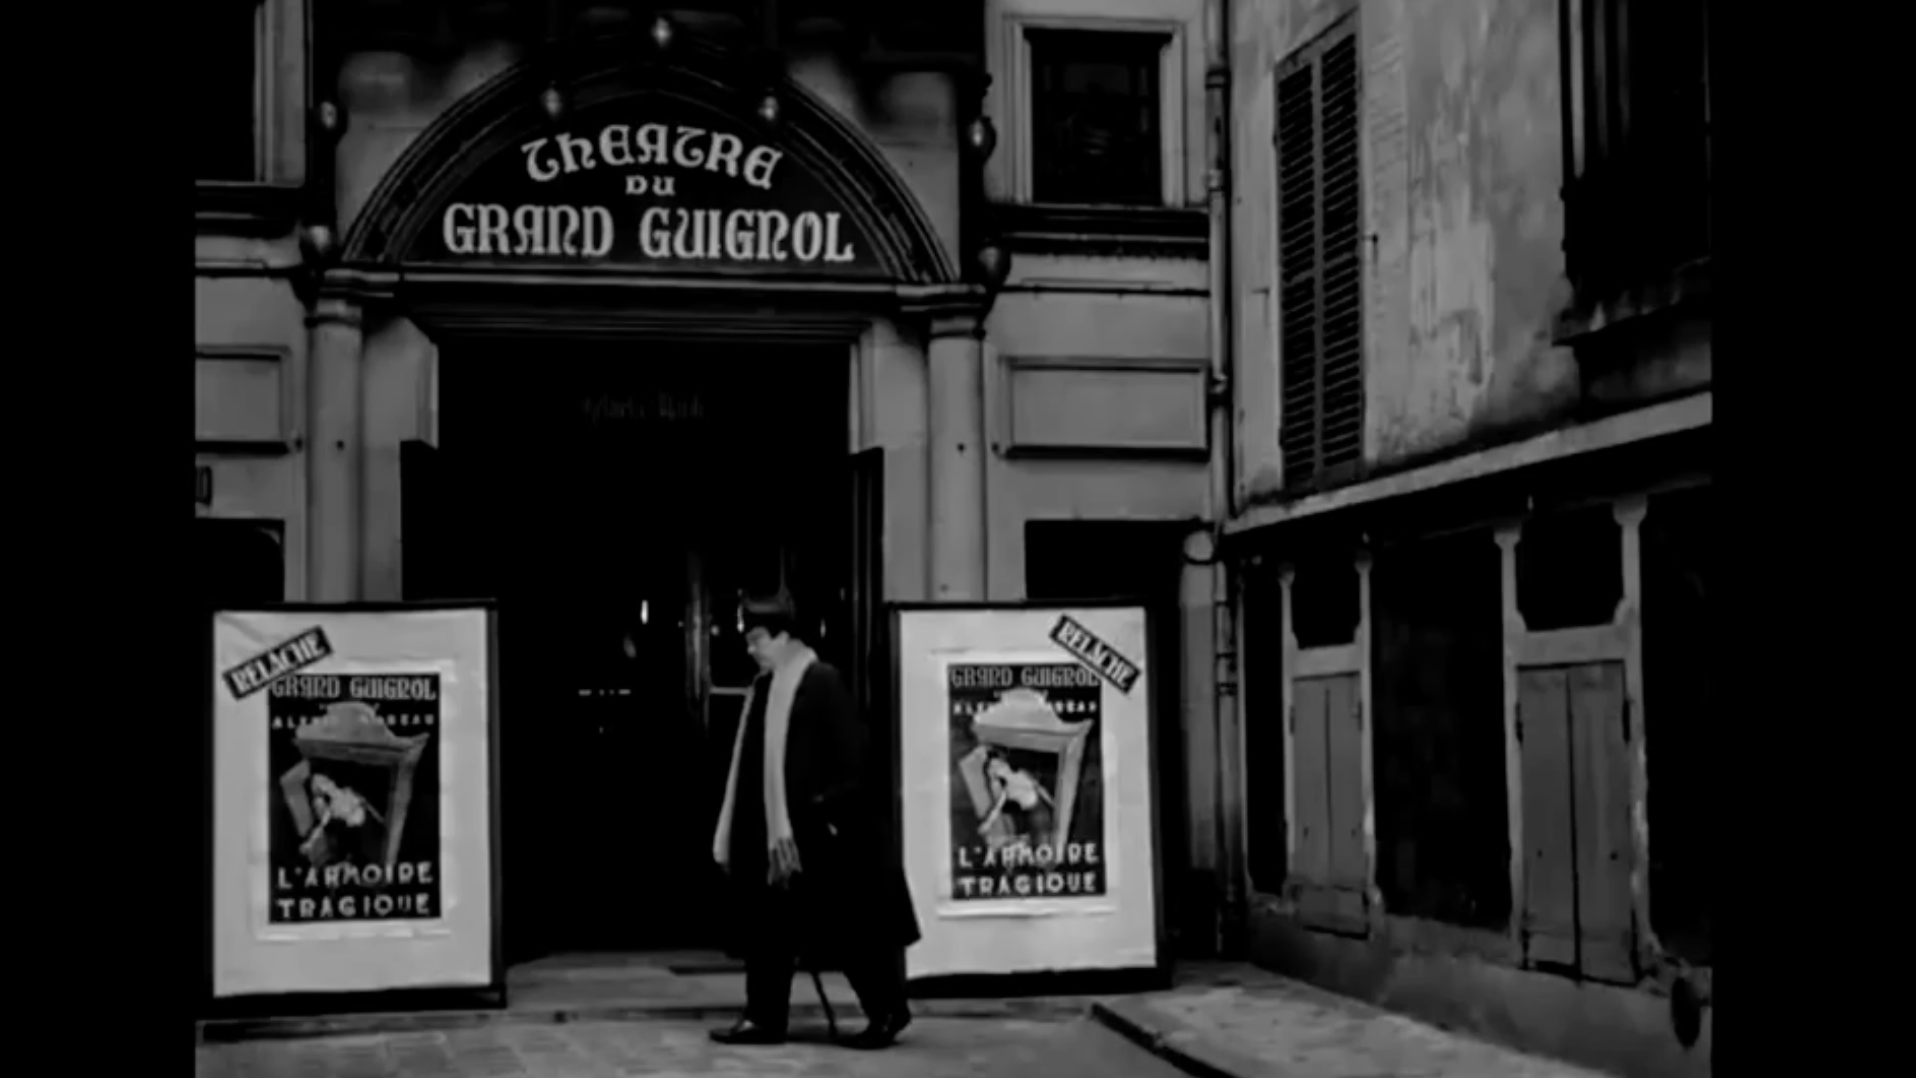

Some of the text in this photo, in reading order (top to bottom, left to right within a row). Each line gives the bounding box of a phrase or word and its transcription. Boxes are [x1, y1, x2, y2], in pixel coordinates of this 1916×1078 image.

[624, 174, 677, 196] DU
[442, 203, 855, 262] GRAND GUIGNOL
[350, 677, 437, 700] GUIGNOL
[958, 842, 1099, 868] L'ARMOIRE
[278, 862, 433, 889] L'ARMOIRE
[957, 872, 1096, 897] TRAGIQUE
[276, 892, 430, 917] TRAGIQUE
